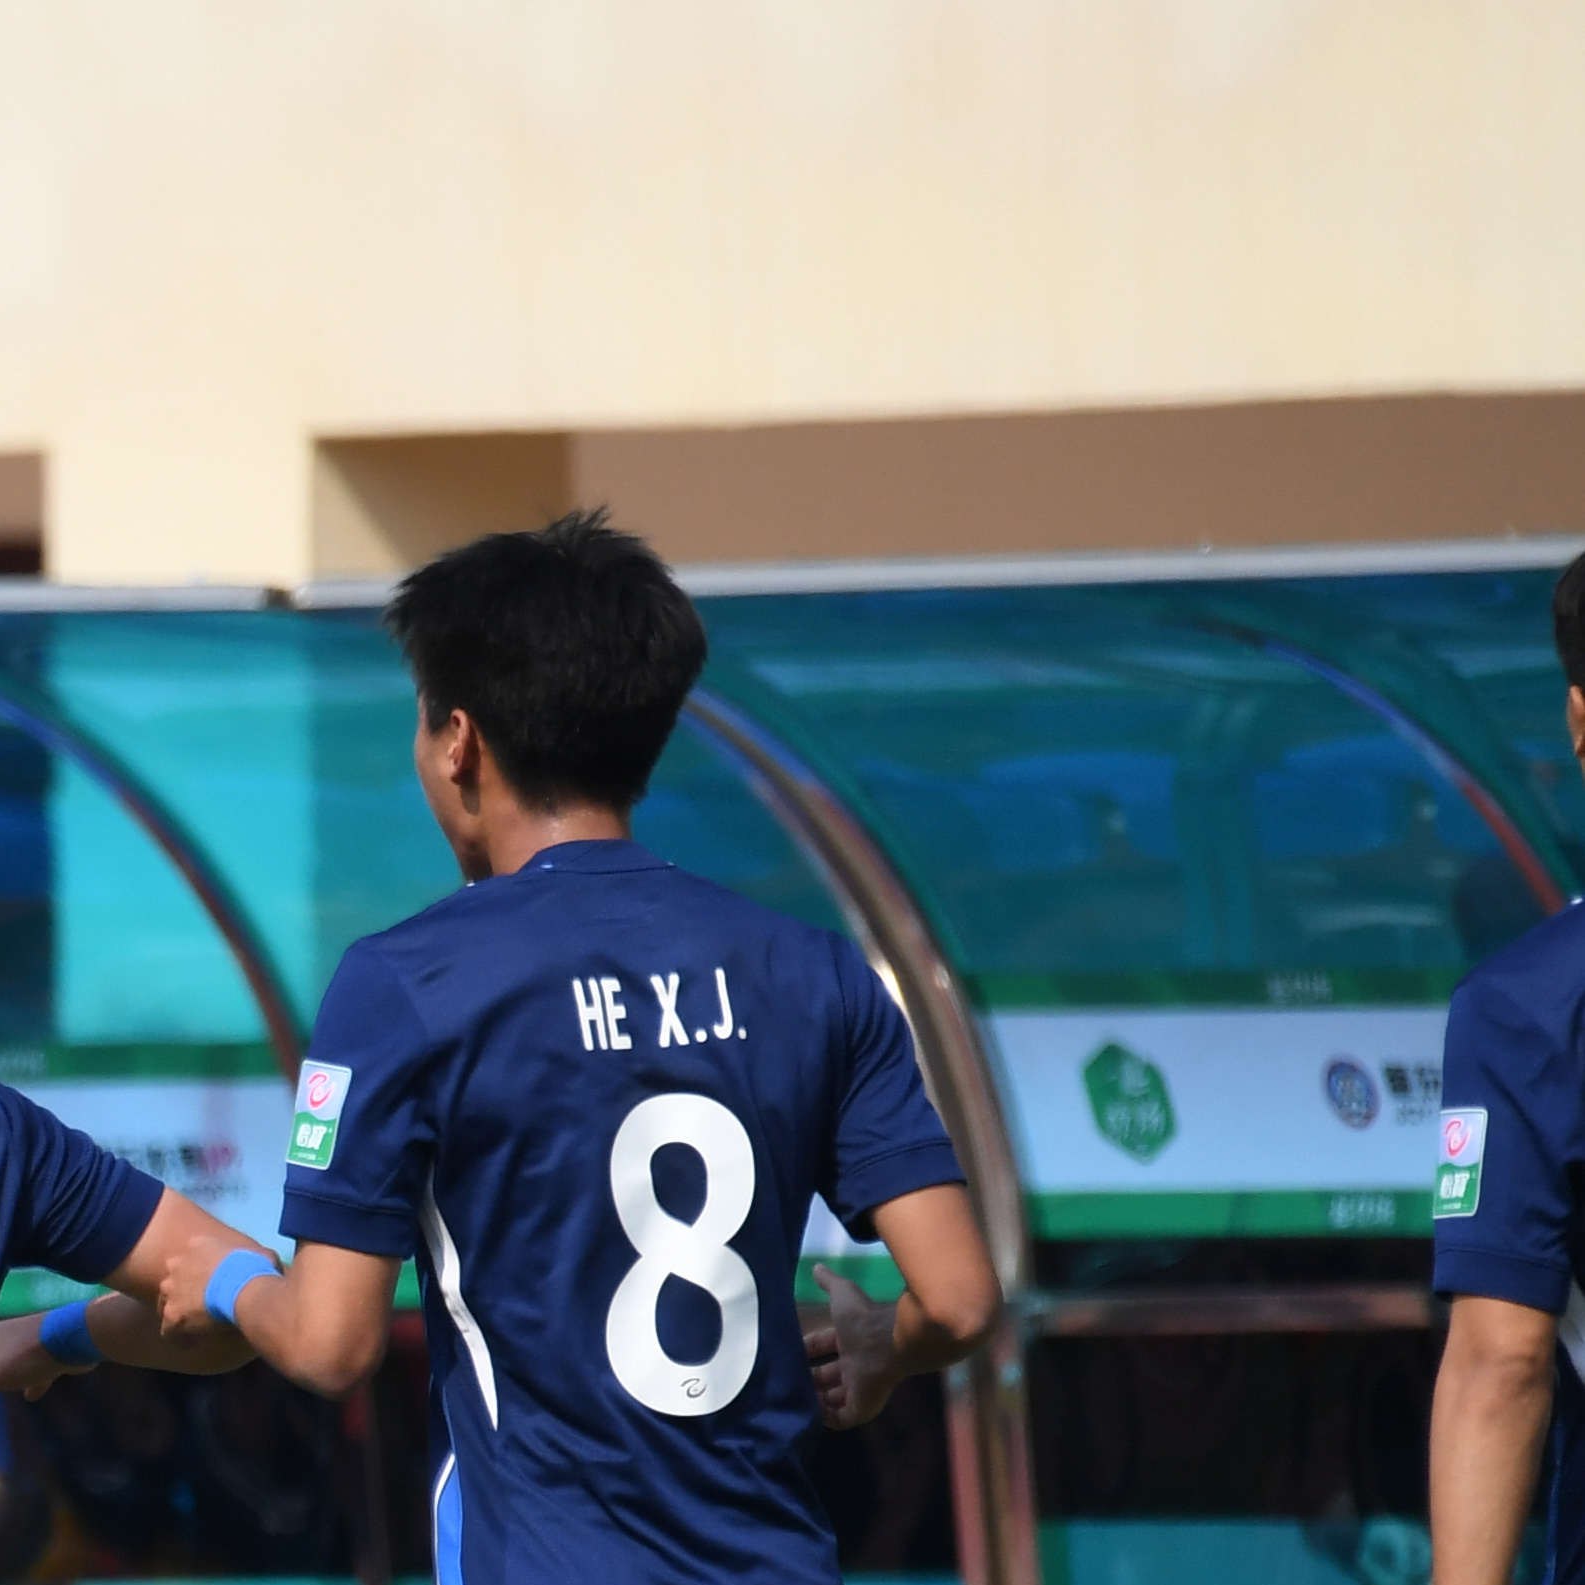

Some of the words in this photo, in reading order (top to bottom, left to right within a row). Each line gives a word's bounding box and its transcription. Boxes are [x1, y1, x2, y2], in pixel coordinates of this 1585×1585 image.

[572, 976, 633, 1052] HE
[649, 967, 748, 1049] X.J.
[605, 1093, 760, 1417] 8
